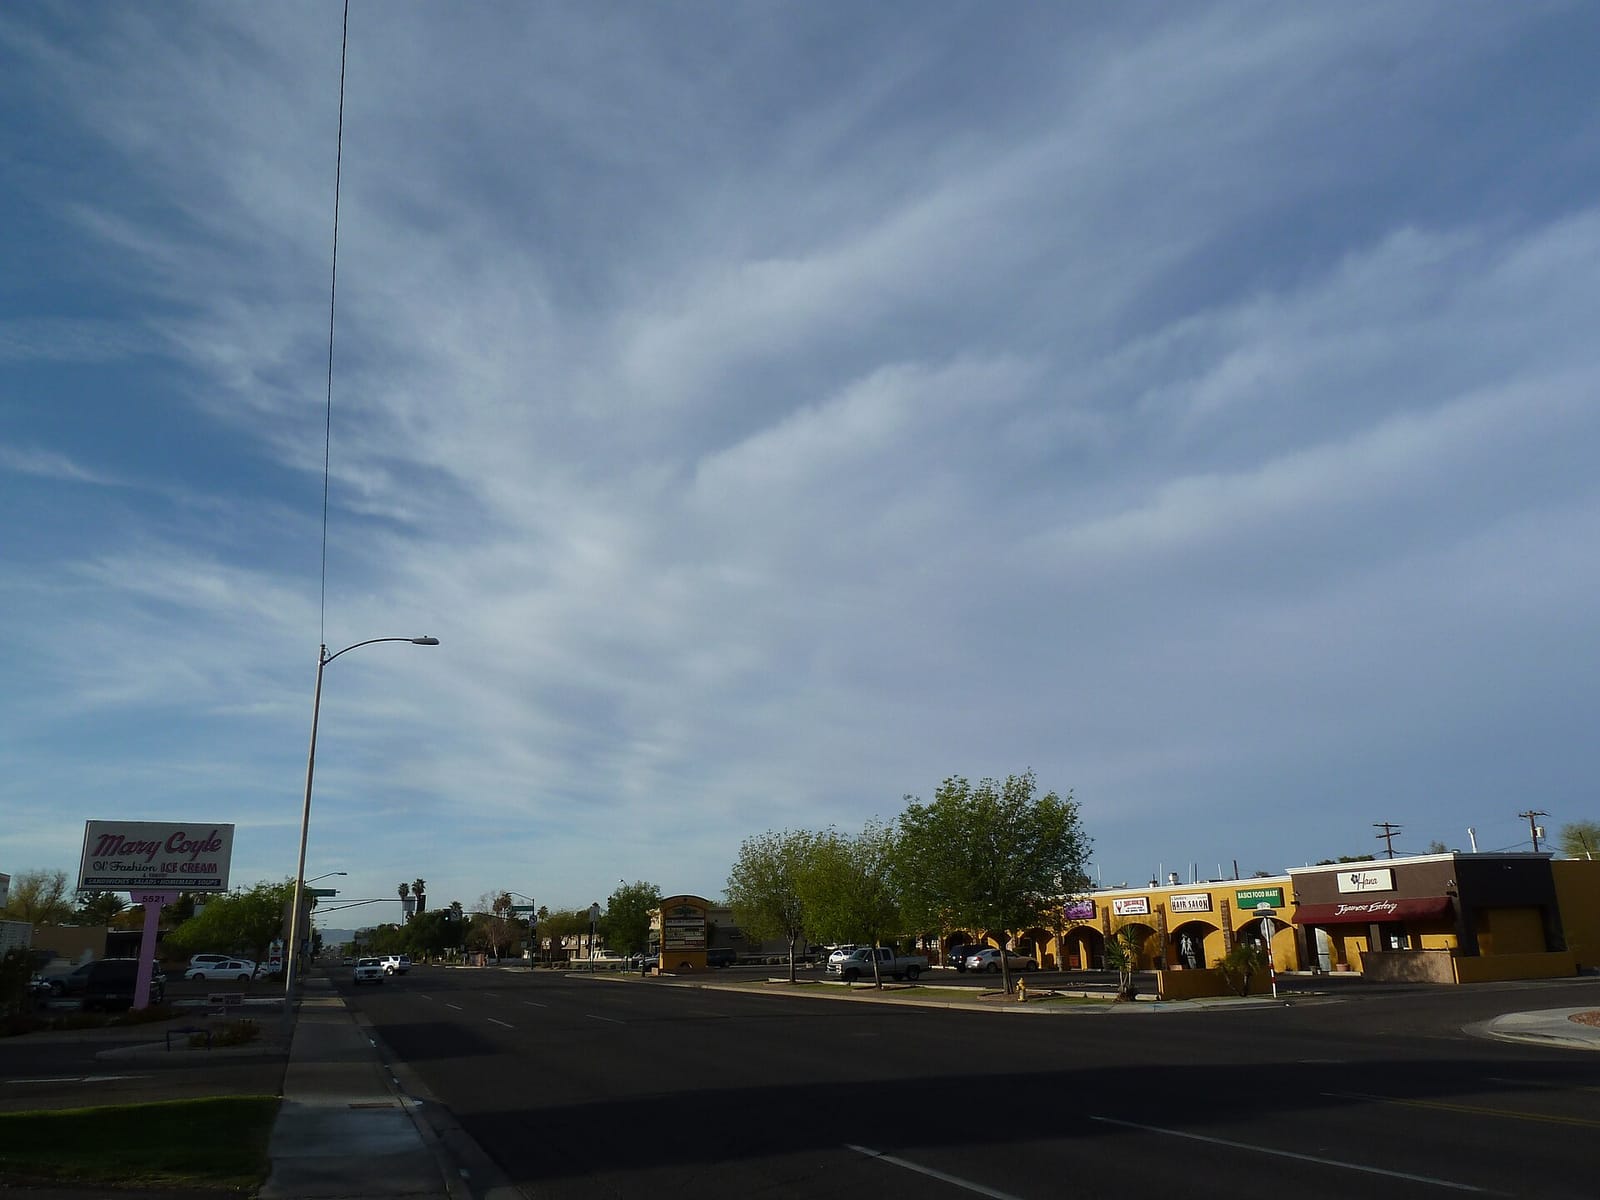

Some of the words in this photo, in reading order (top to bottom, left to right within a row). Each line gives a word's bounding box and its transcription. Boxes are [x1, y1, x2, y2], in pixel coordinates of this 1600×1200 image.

[92, 834, 162, 863] Mary
[165, 830, 222, 861] Coyle
[109, 861, 157, 873] Fashion
[160, 863, 178, 873] ICE
[179, 863, 218, 873] CREAM
[1356, 873, 1377, 890] Hana
[142, 895, 165, 903] 5521
[1172, 900, 1187, 910] HAIR
[1188, 899, 1208, 909] SALON
[1334, 904, 1368, 916] Japanese
[1367, 900, 1398, 915] Eatery
